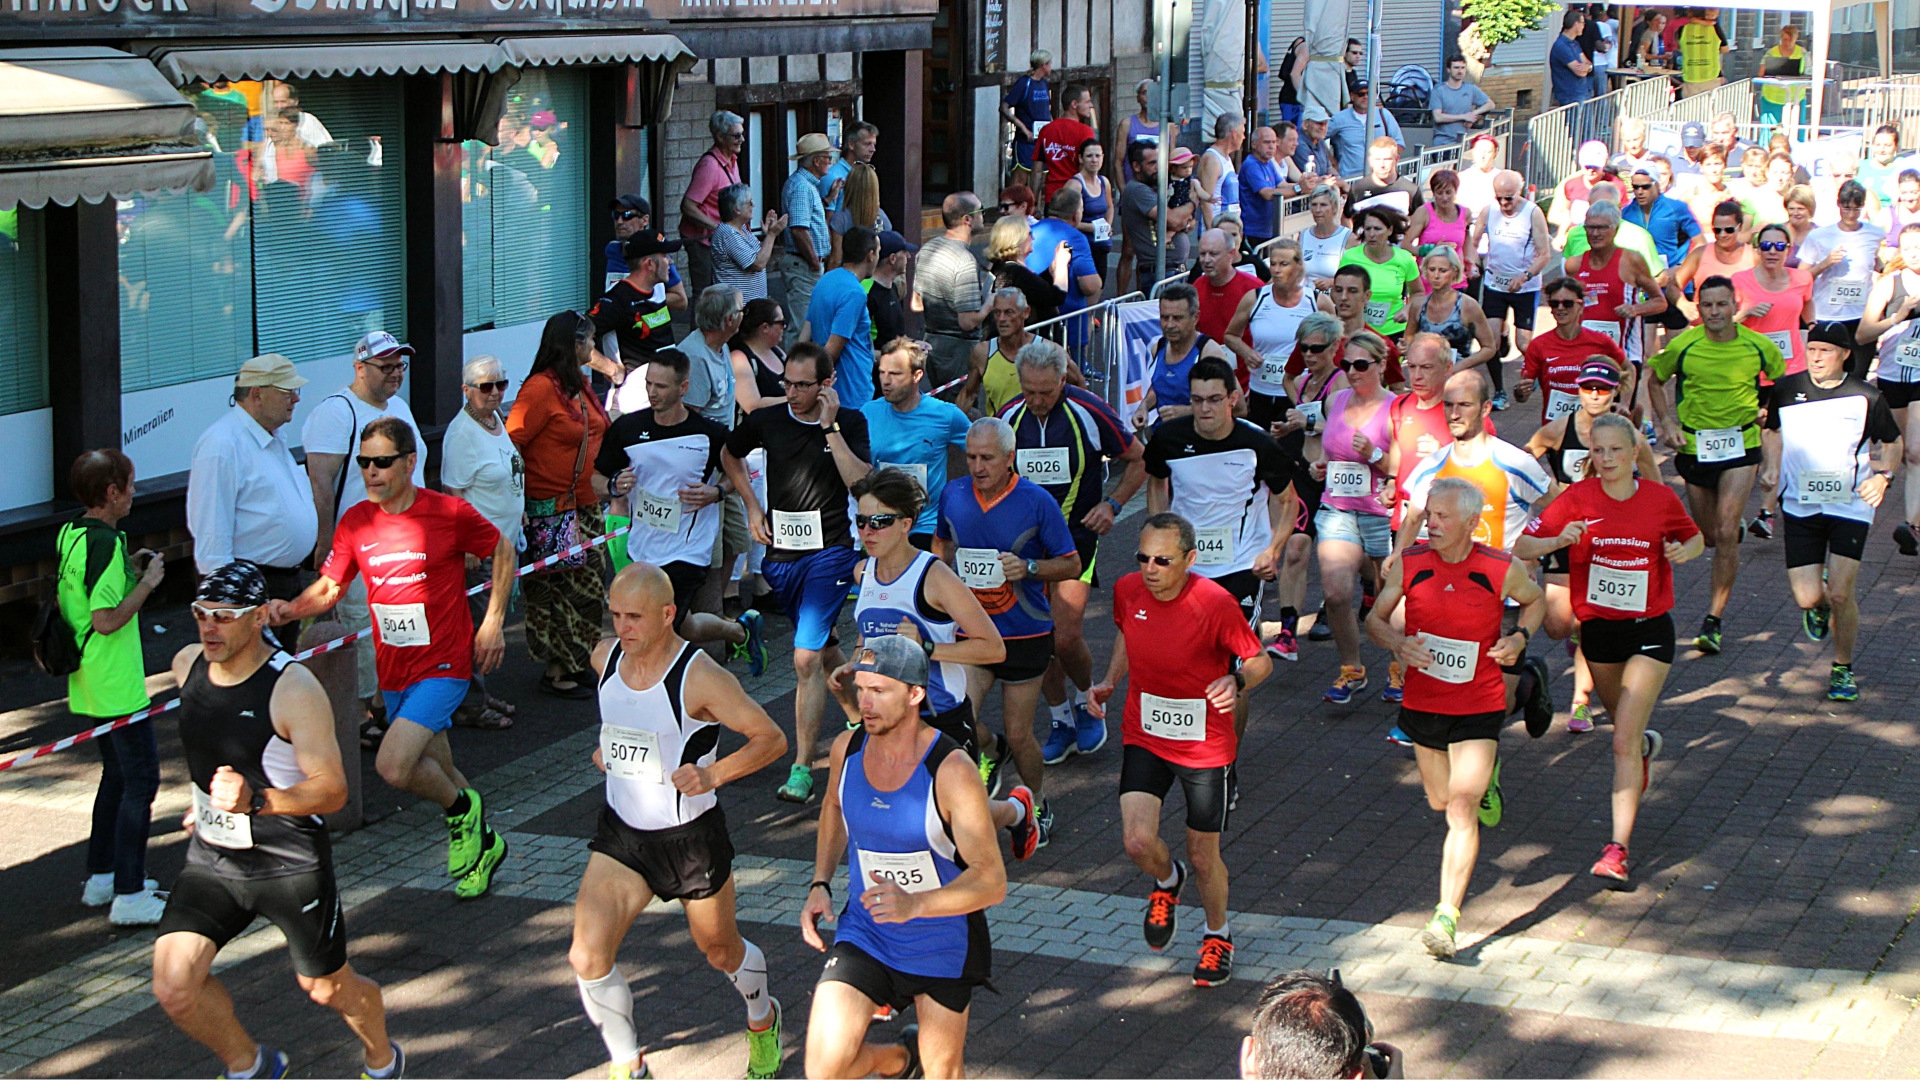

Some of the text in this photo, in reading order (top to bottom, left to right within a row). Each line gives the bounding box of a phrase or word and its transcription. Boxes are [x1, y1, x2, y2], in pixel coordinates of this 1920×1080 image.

[1836, 286, 1862, 298] 5052
[1904, 346, 1920, 358] 50
[1265, 363, 1285, 375] 504
[1705, 436, 1736, 451] 5070
[1026, 460, 1061, 473] 5026
[1333, 472, 1363, 485] 5005
[1807, 480, 1842, 493] 5050
[643, 500, 672, 520] 5047
[780, 523, 812, 537] 5000
[1195, 538, 1224, 552] 044
[1591, 536, 1651, 549] Gymnasium
[1592, 553, 1650, 568] Heinzenwies
[964, 560, 995, 576] 5027
[1597, 579, 1637, 597] 5037
[383, 617, 416, 633] 5041
[1151, 709, 1194, 727] 5030
[610, 742, 650, 764] 5077
